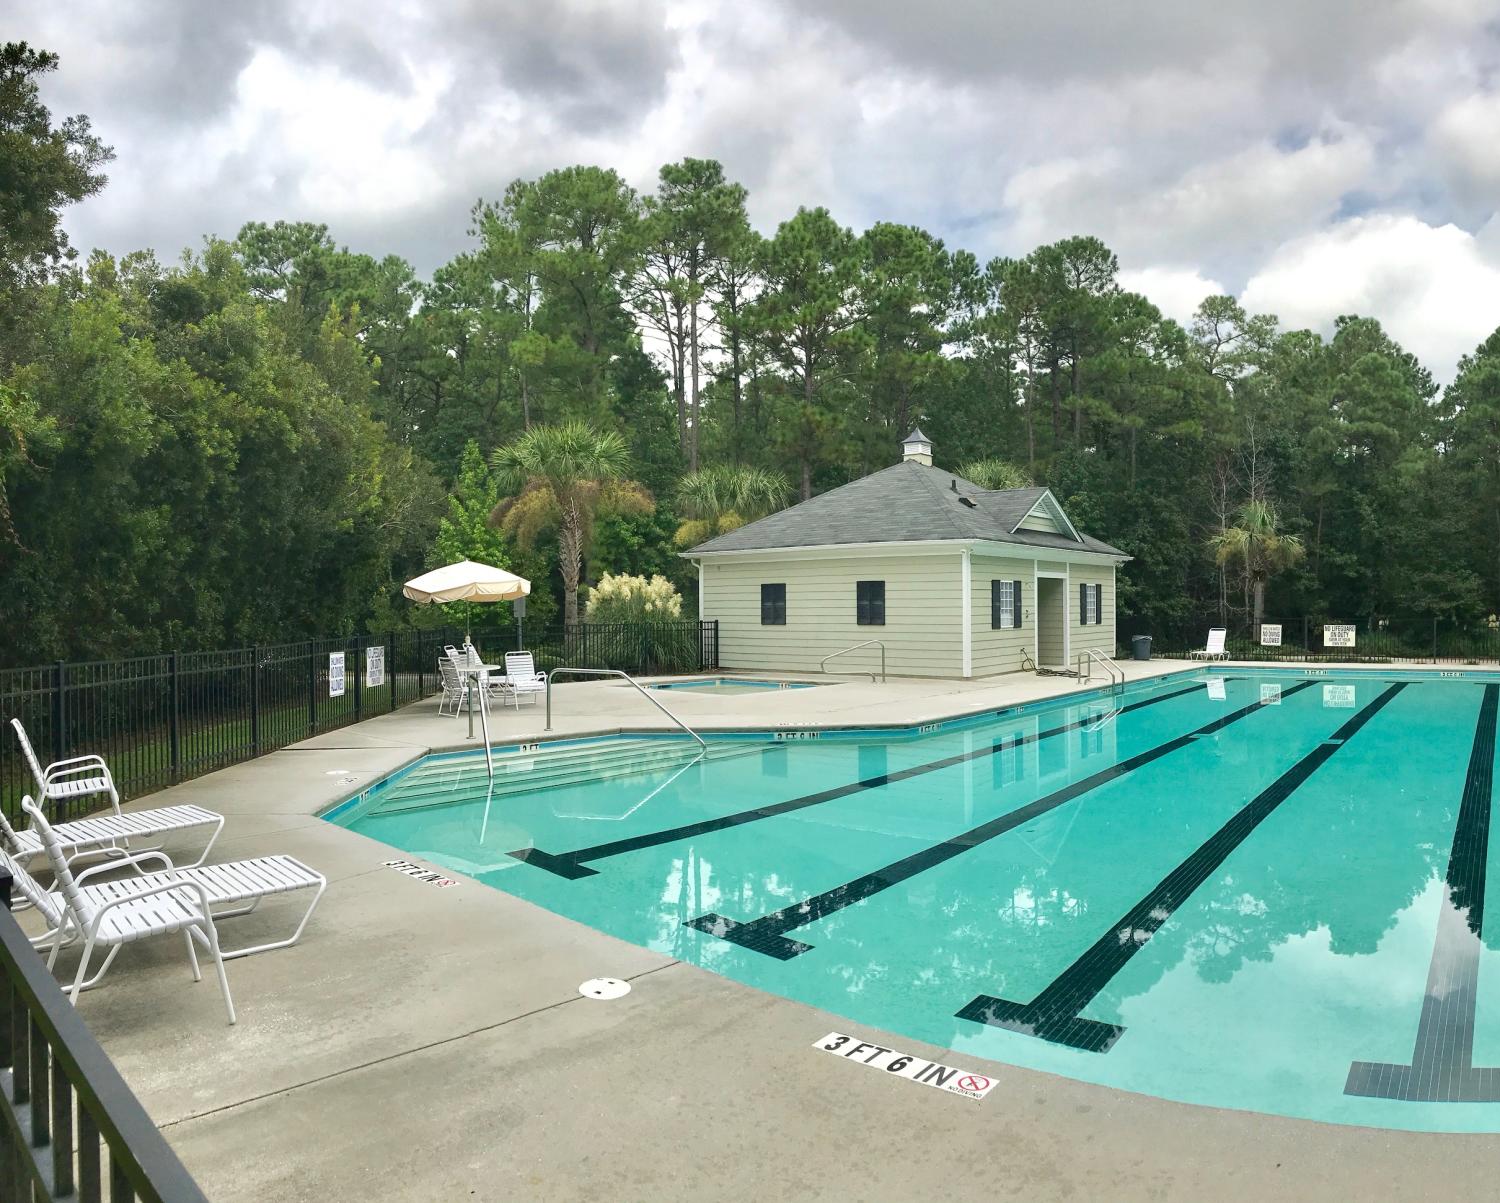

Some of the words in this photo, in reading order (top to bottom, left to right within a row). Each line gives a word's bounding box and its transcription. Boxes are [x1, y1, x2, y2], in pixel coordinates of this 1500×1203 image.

[393, 863, 421, 871] FT
[418, 873, 445, 882] IN
[824, 1036, 850, 1051] 3
[844, 1042, 892, 1064] FT
[886, 1056, 914, 1072] 6
[913, 1063, 959, 1087] IN
